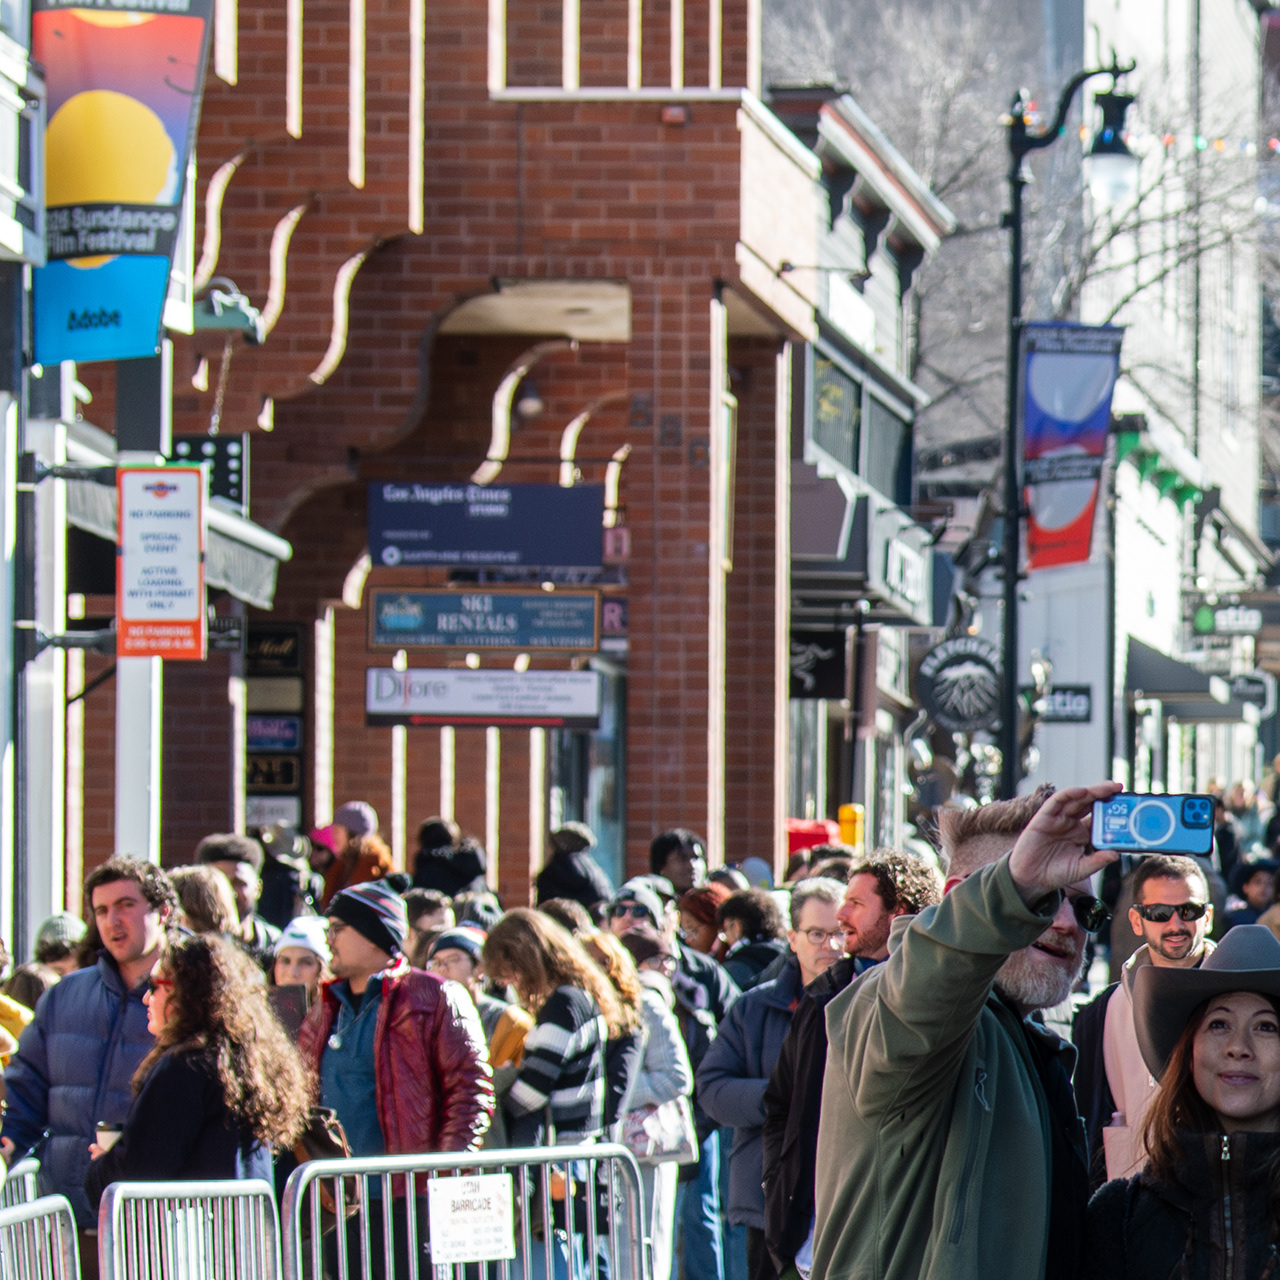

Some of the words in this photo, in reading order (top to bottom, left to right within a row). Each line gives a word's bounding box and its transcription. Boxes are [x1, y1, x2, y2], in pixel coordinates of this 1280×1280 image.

[71, 206, 176, 231] Sundance
[77, 229, 156, 251] Festival
[67, 307, 122, 331] Adobe
[629, 396, 710, 467] 580
[145, 510, 191, 519] PARKING
[461, 595, 493, 612] SKI
[437, 613, 518, 632] RENTALS
[1215, 606, 1262, 632] stio
[450, 1197, 492, 1213] BARRICADE
